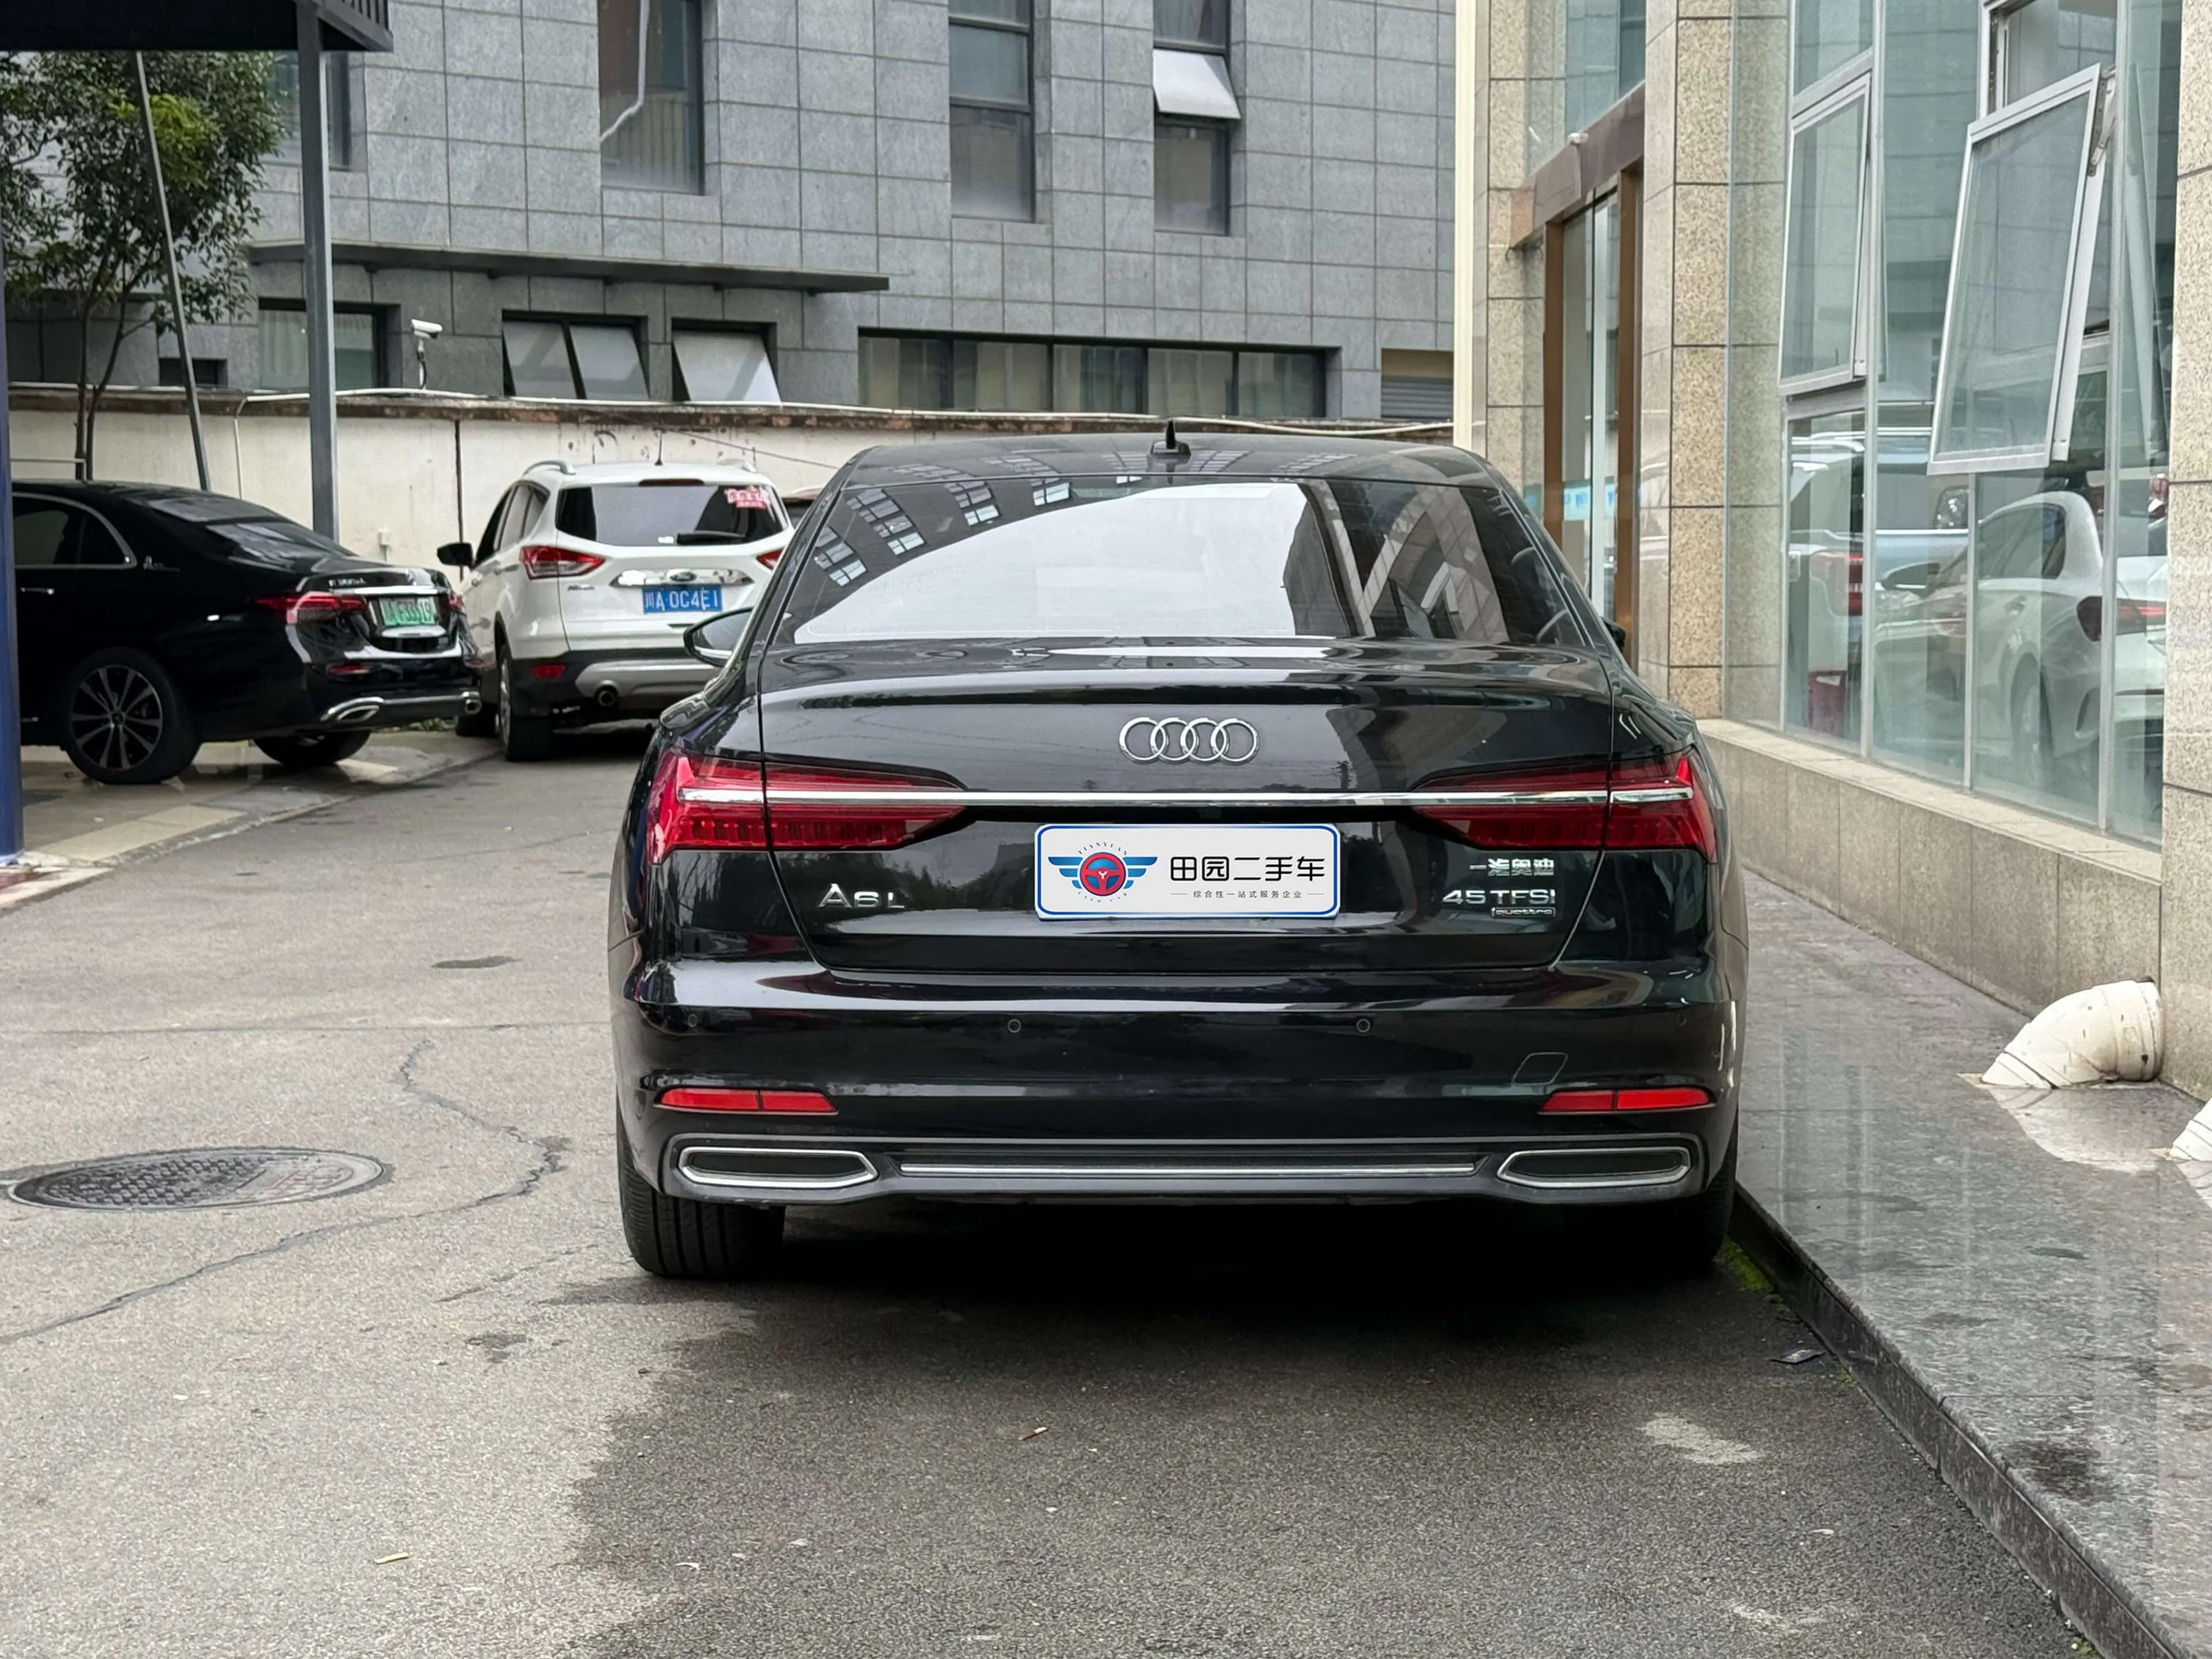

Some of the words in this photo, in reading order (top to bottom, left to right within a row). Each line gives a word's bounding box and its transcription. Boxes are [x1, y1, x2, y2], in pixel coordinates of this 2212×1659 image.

[1469, 858, 1554, 876] 一汽奥迪
[819, 883, 905, 908] A6L
[1442, 890, 1486, 904] 45
[1490, 889, 1555, 904] TFSI
